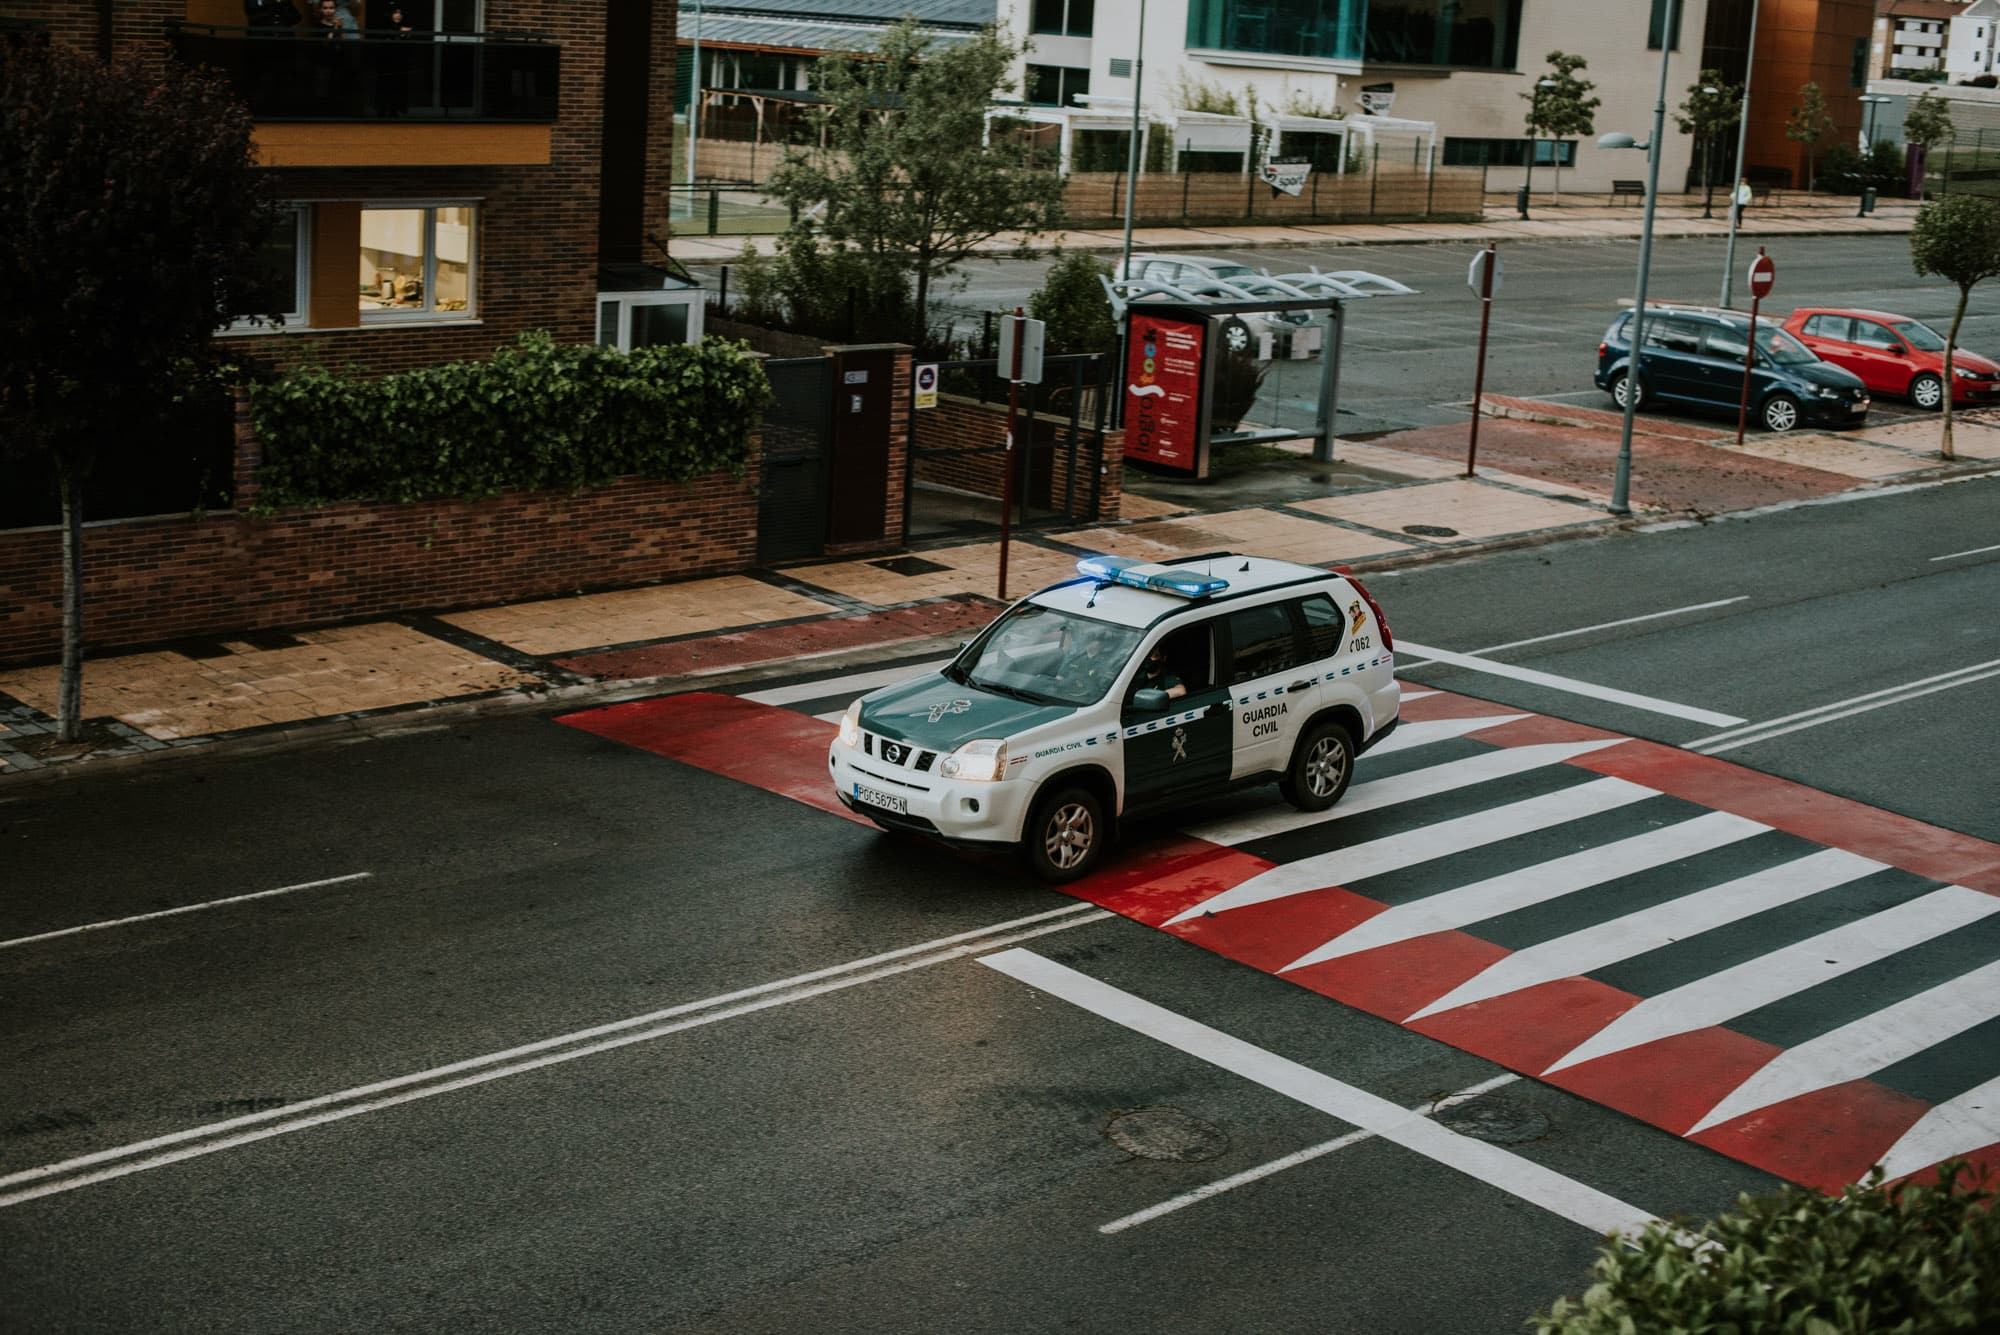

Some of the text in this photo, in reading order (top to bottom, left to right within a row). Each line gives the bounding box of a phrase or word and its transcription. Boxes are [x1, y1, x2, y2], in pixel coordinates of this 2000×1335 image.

[1355, 636, 1371, 652] 062
[1242, 702, 1288, 724] GUARDIA
[1252, 720, 1279, 737] CIVIL
[1035, 742, 1083, 759] GUARDIA CIVIL
